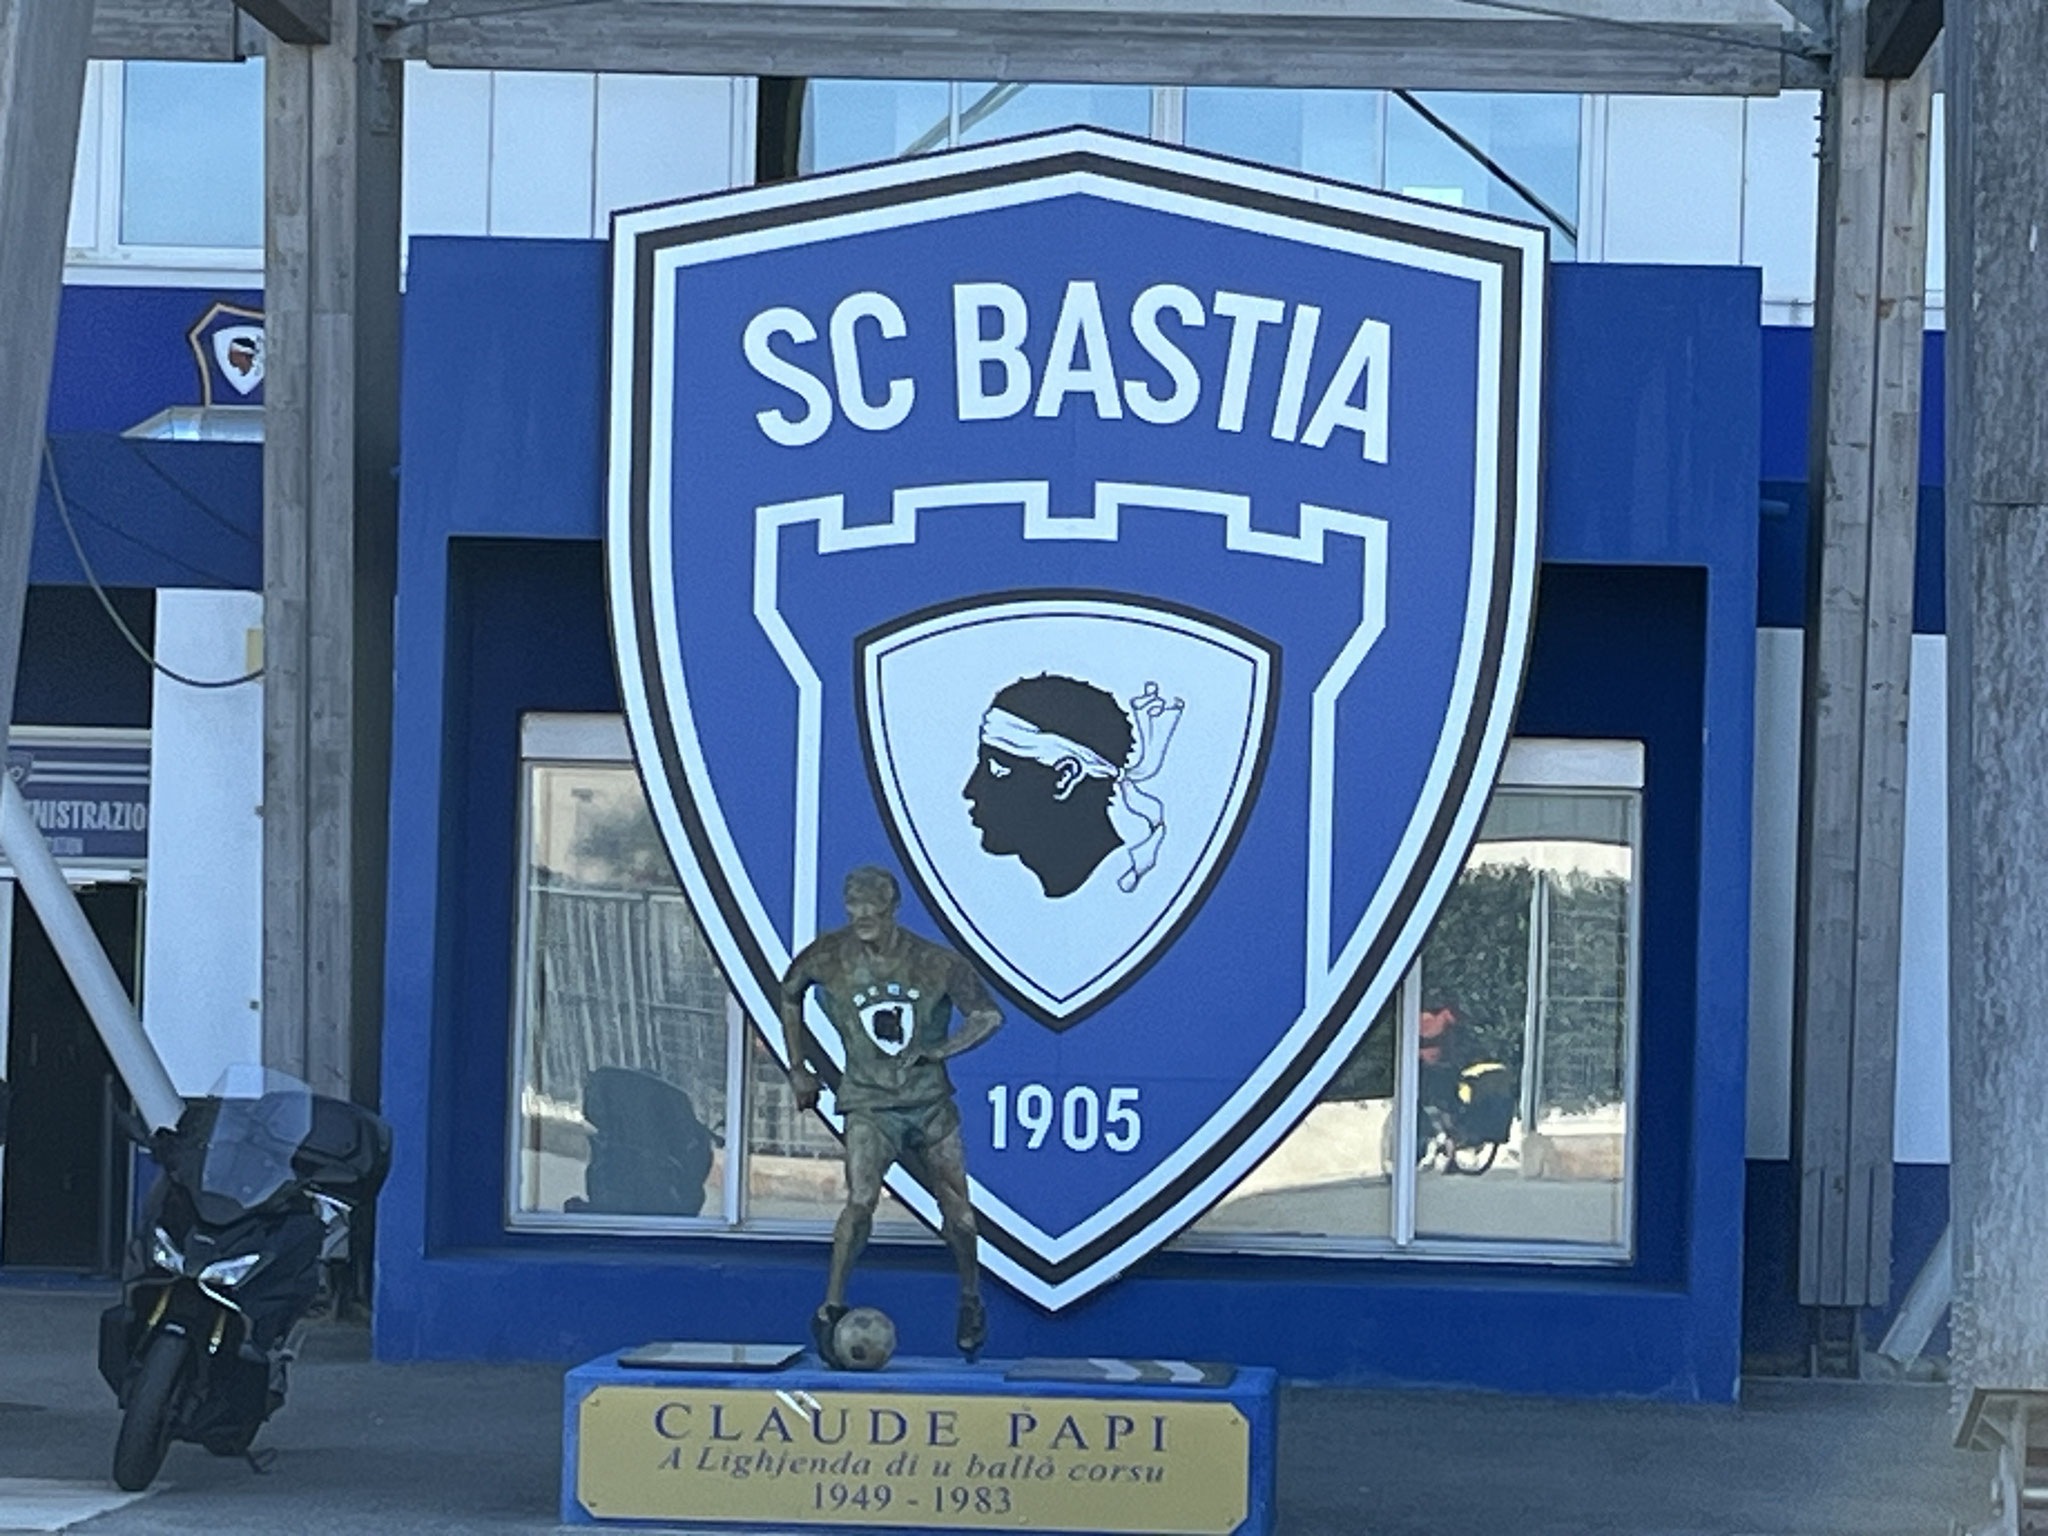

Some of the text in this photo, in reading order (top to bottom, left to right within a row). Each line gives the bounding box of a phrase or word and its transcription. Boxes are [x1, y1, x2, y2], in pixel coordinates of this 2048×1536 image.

[743, 280, 1392, 464] SC BASTIA
[987, 1084, 1142, 1152] 1905
[654, 1402, 1167, 1452] CLAUDE PAPI
[658, 1446, 681, 1470] A
[697, 1446, 871, 1479] Lighjenda
[885, 1452, 919, 1477] di
[932, 1460, 952, 1477] u
[1068, 1464, 1164, 1483] corsu
[815, 1482, 892, 1511] 1949
[935, 1485, 1012, 1514] 1983
